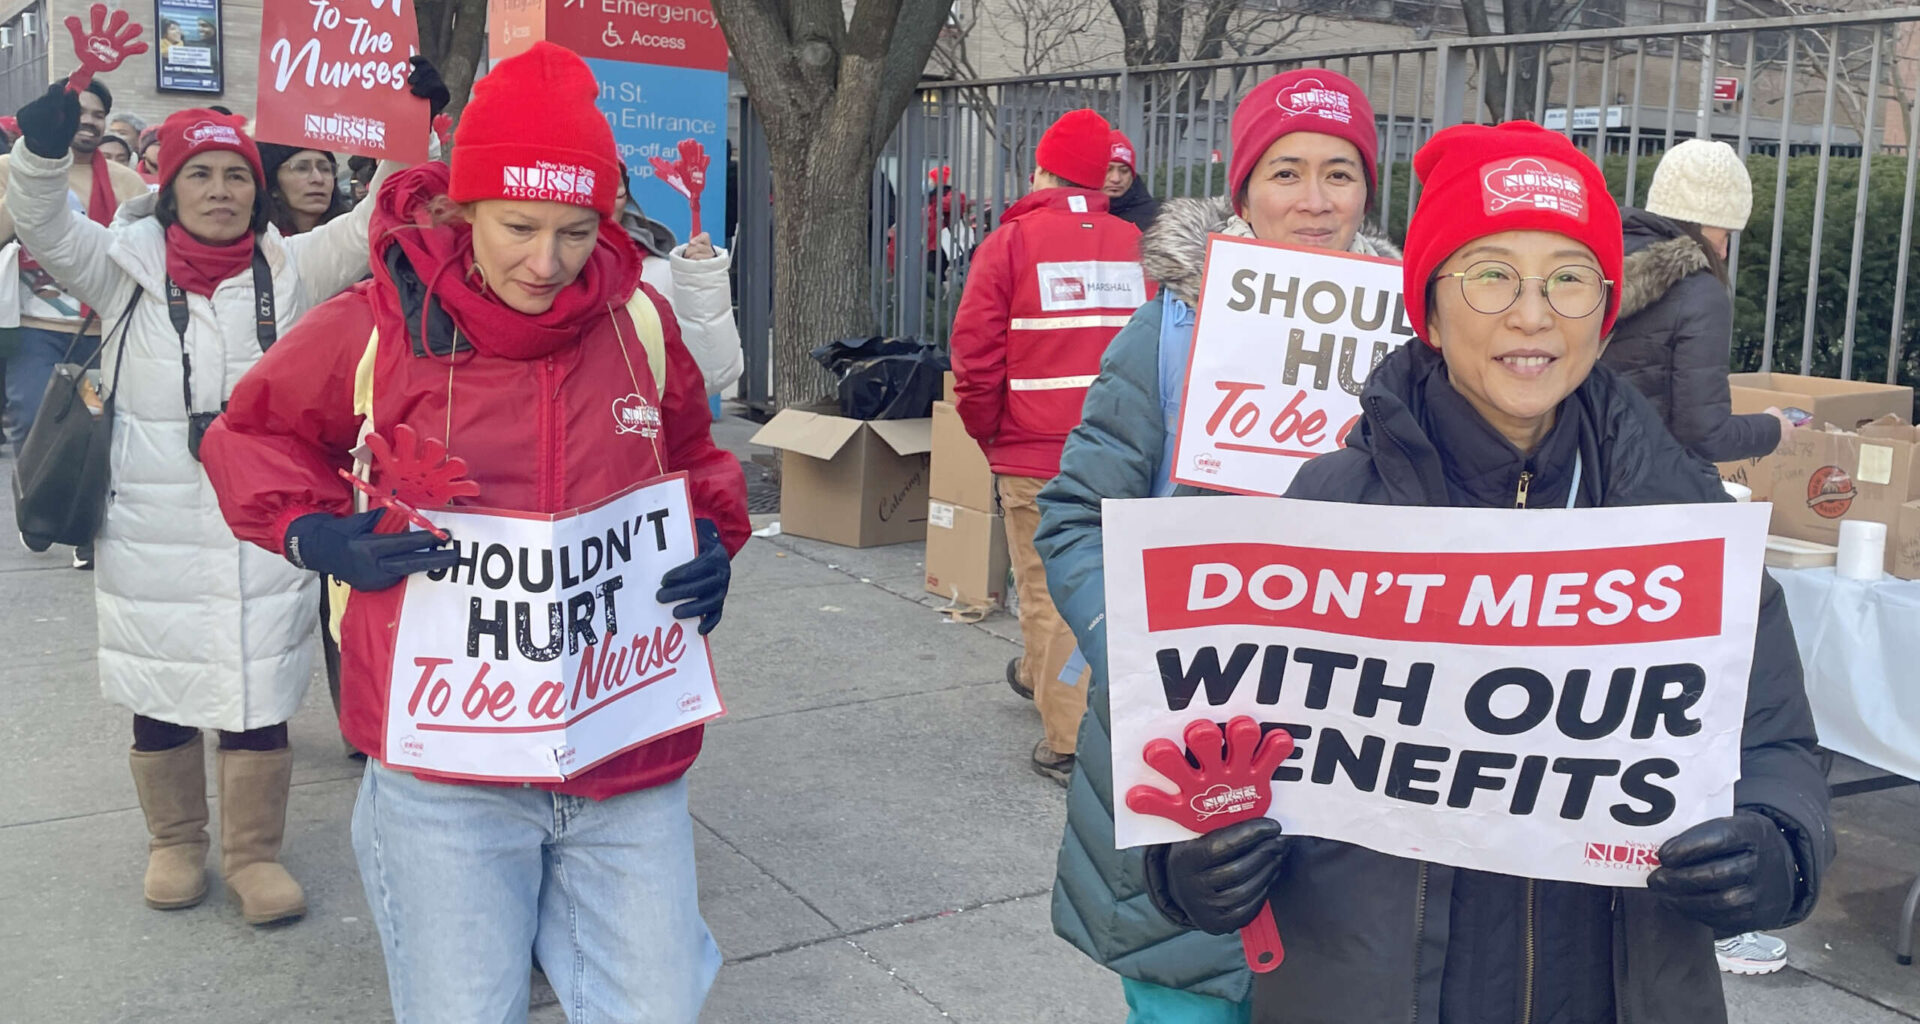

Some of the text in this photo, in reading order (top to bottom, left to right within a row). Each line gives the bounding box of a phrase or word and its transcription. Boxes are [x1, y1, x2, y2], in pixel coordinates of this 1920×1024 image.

[309, 0, 341, 32] To
[601, 0, 718, 28] Emergency
[345, 17, 393, 56] The
[631, 31, 686, 50] Access
[620, 82, 647, 103] St.
[304, 114, 385, 143] NURSES
[622, 108, 716, 134] Entrance
[304, 130, 385, 150] ASSOCIATION
[662, 148, 683, 159] an
[504, 165, 595, 196] NURSES
[536, 160, 557, 171] New
[559, 162, 577, 174] York
[503, 186, 593, 206] ASSOCIATION
[1503, 173, 1581, 195] NURSES
[1087, 283, 1131, 292] MARSHALL
[1282, 328, 1389, 397] HU
[1206, 381, 1266, 437] To
[1270, 389, 1328, 447] be
[1187, 562, 1684, 627] DON'T MESS
[466, 575, 624, 662] HURT
[408, 622, 686, 722] To be a Nurse
[1156, 643, 1706, 740] WITH OUR
[1624, 840, 1647, 849] New
